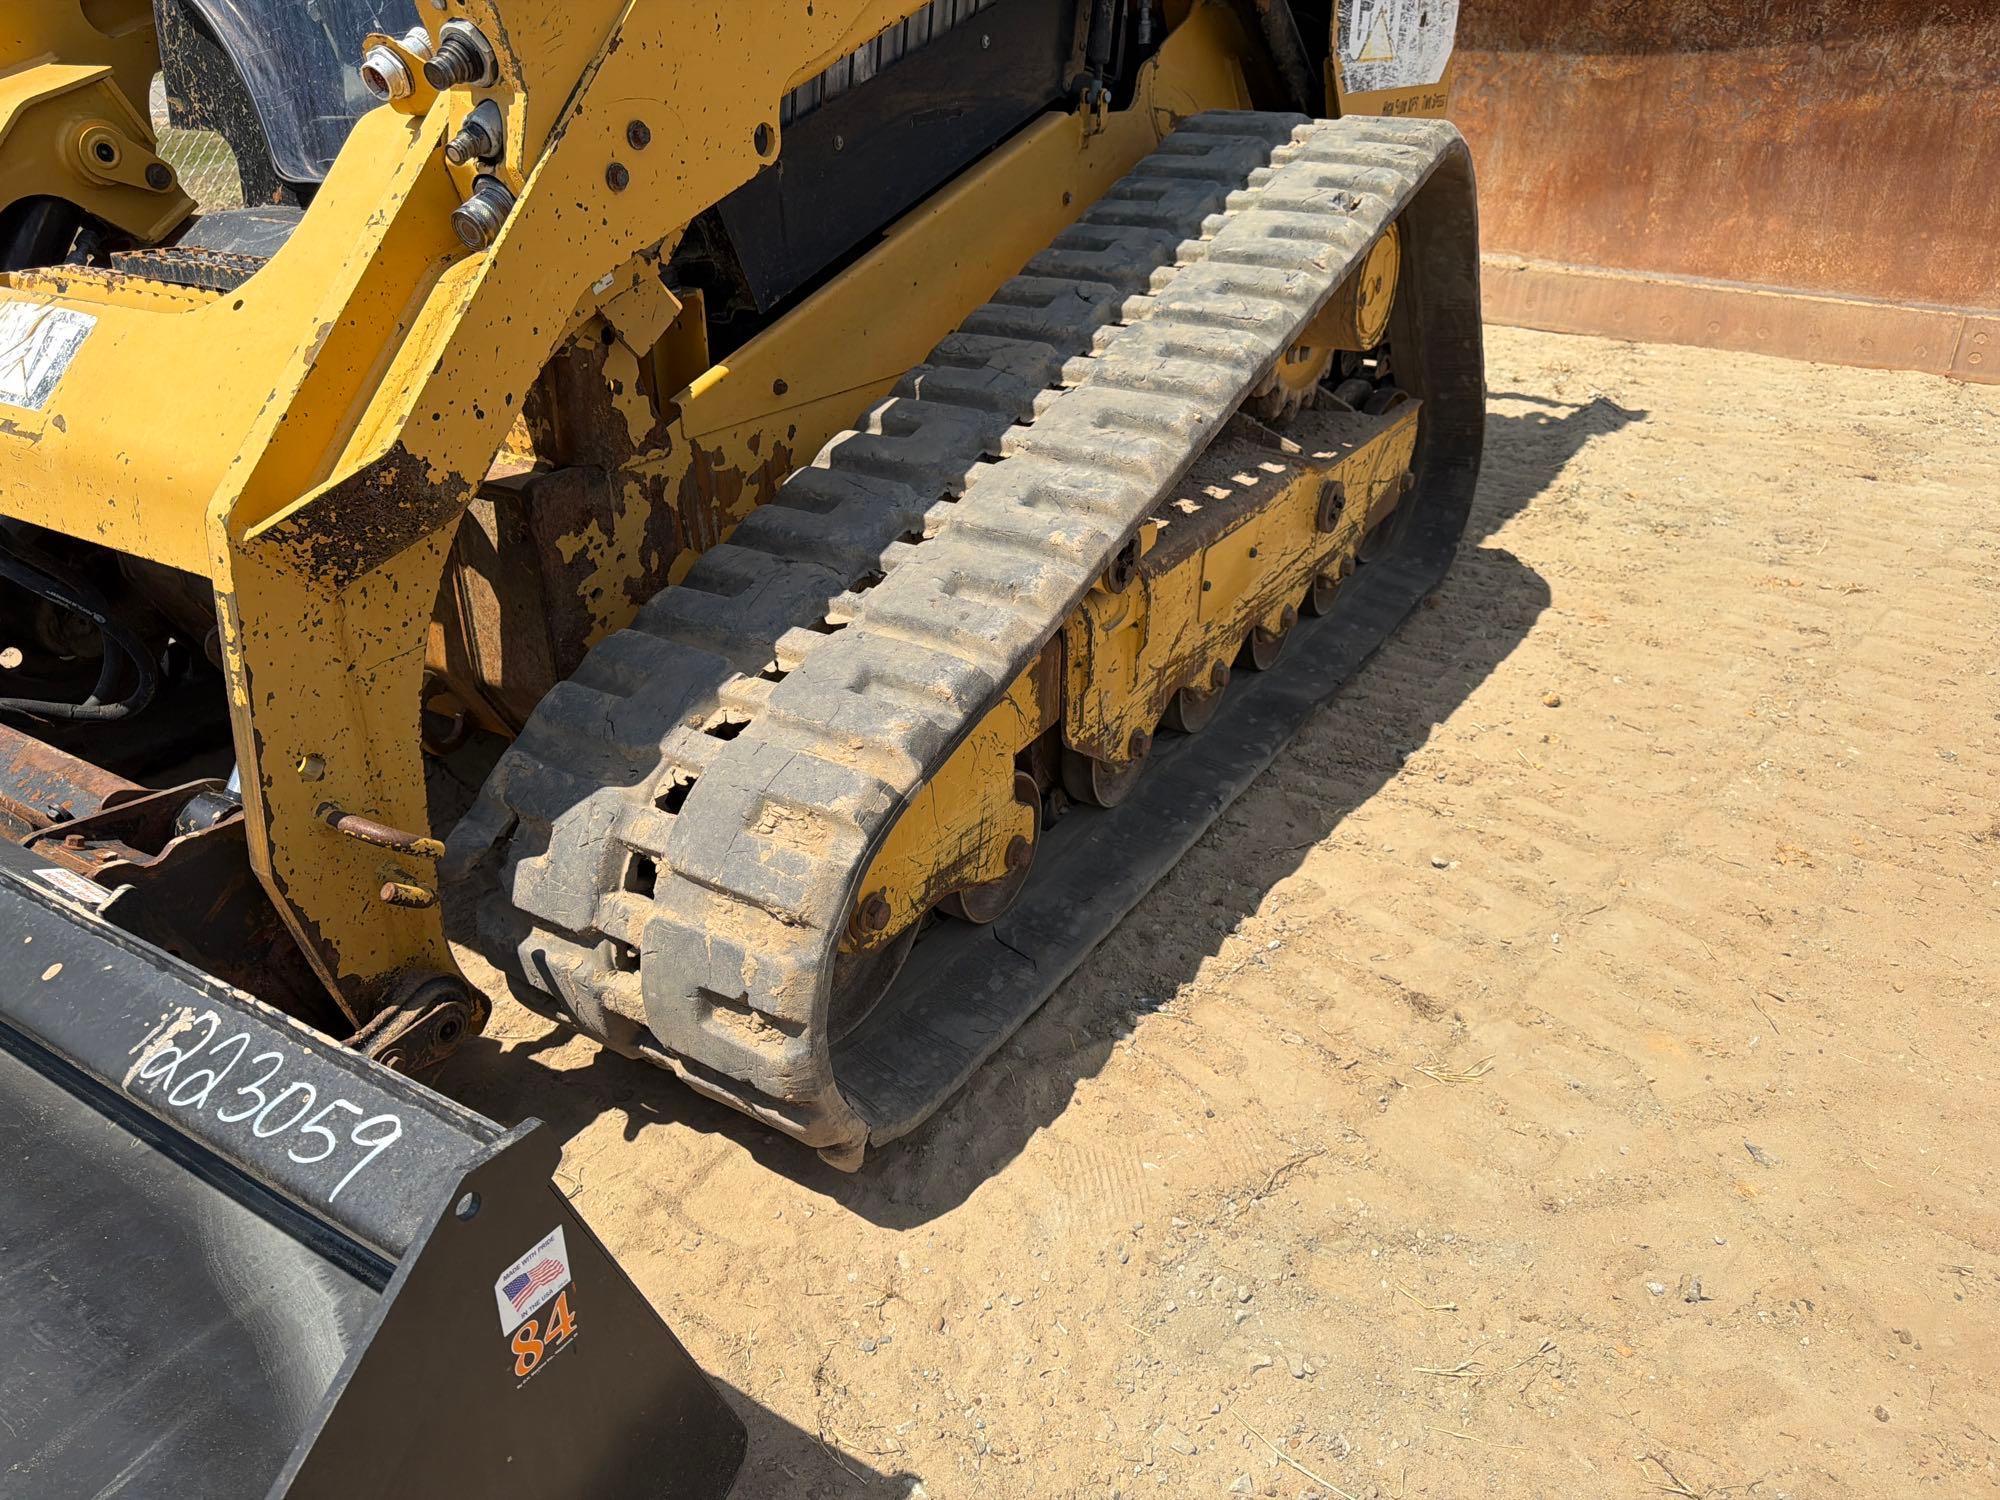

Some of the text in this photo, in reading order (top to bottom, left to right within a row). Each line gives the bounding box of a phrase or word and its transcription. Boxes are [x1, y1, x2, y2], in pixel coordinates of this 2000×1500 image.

[140, 1009, 403, 1203] 223059
[503, 1235, 555, 1281] MADE WITH PRIDE
[511, 1290, 578, 1377] 84
[520, 1289, 553, 1320] IN THE USA
